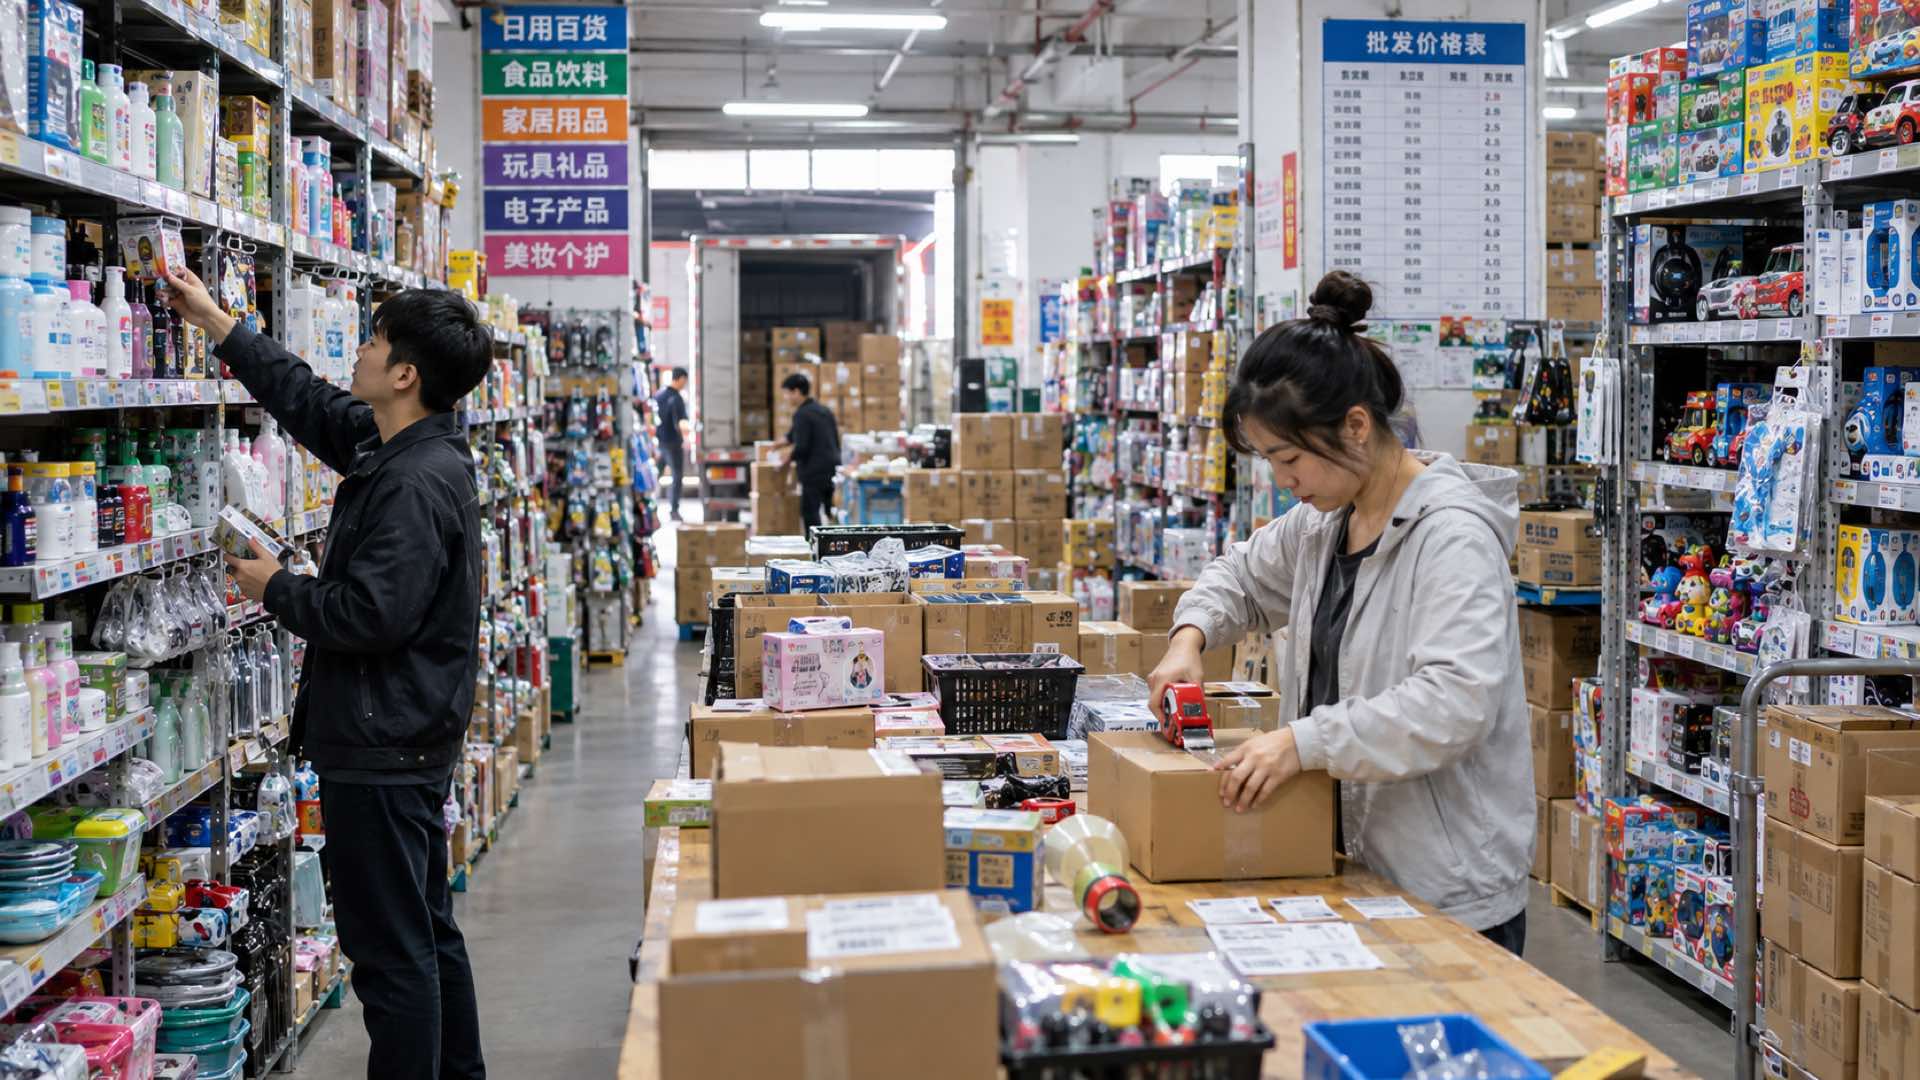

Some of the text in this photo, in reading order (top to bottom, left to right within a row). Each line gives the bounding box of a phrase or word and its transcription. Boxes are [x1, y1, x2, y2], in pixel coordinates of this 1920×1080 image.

[503, 14, 608, 42] 日用百货
[1366, 31, 1487, 56] 批发价格表
[501, 60, 608, 88] 食品饮料
[502, 107, 608, 134] 家居用品
[502, 152, 608, 179] 玩具礼品
[504, 196, 609, 224] 电子产品
[503, 241, 609, 270] 美妆个护
